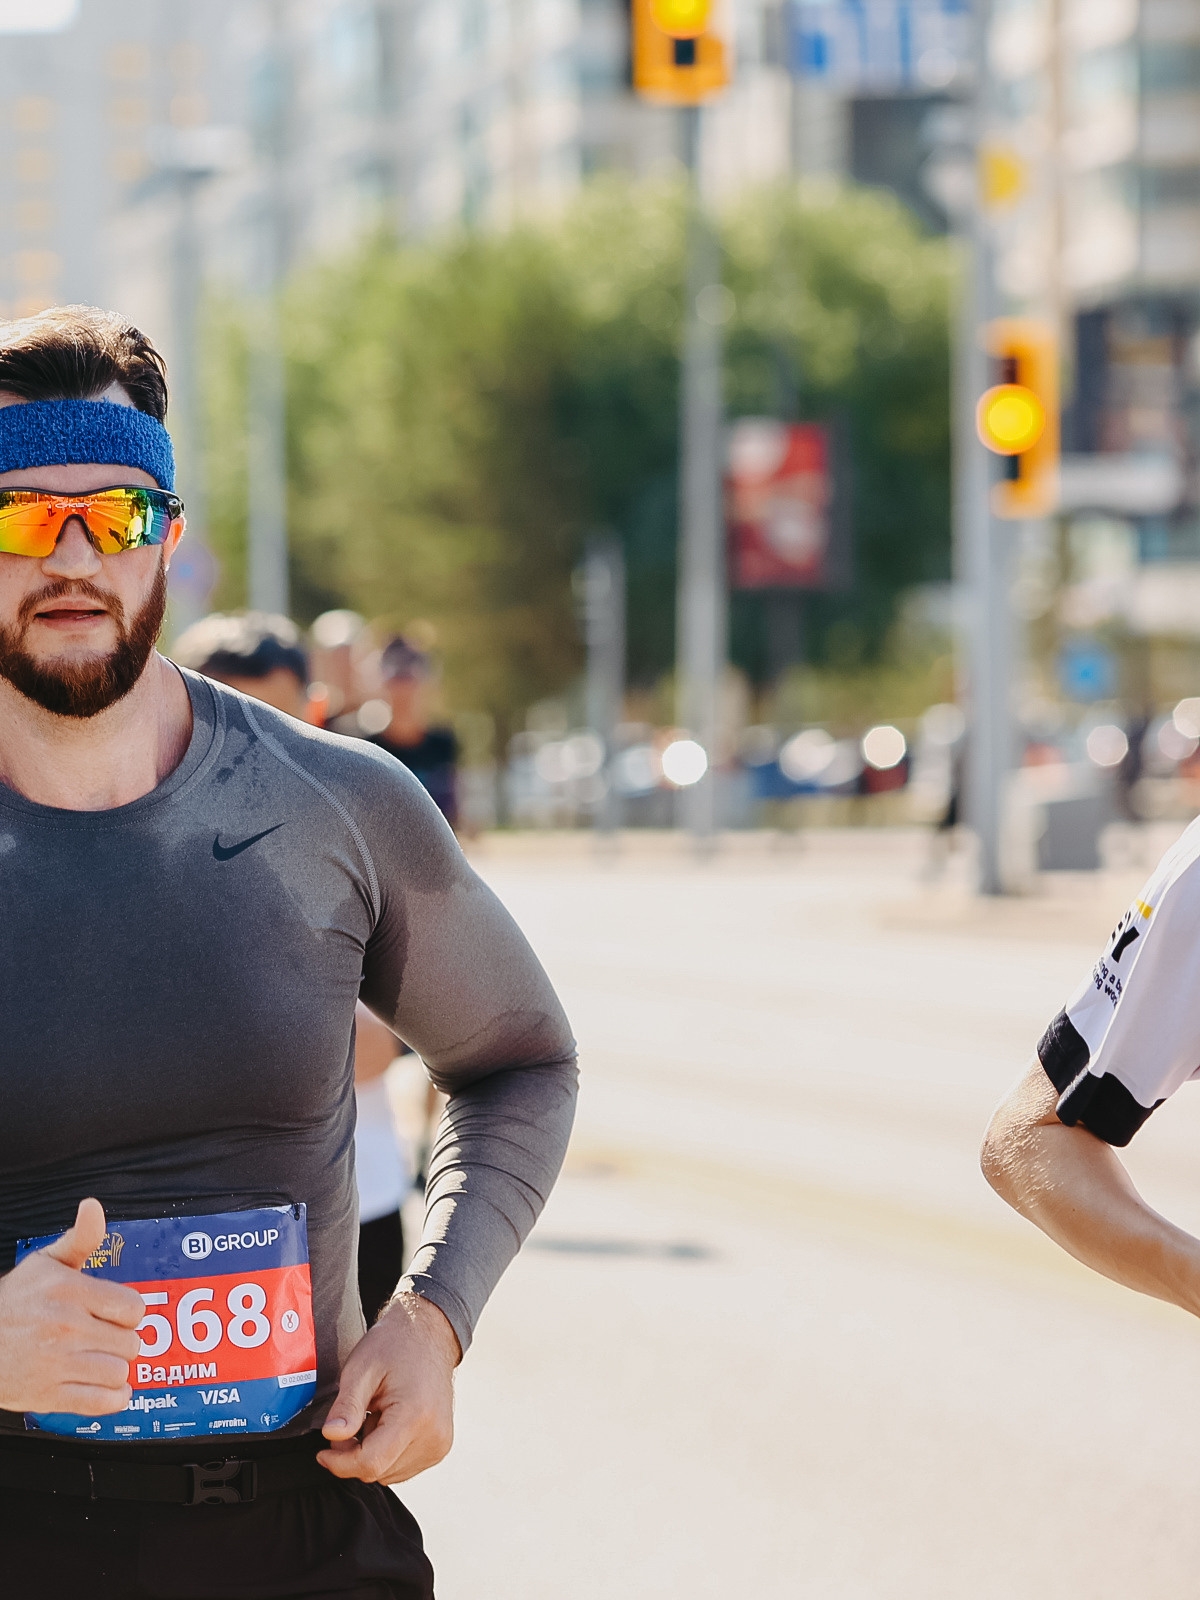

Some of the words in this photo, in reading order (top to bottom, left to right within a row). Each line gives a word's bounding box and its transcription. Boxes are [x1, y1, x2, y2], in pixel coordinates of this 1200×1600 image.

[213, 1228, 279, 1252] GROUP
[135, 1282, 271, 1358] 568
[136, 1362, 217, 1385] Вадим
[121, 1393, 178, 1413] ulpak
[197, 1387, 241, 1405] VISA
